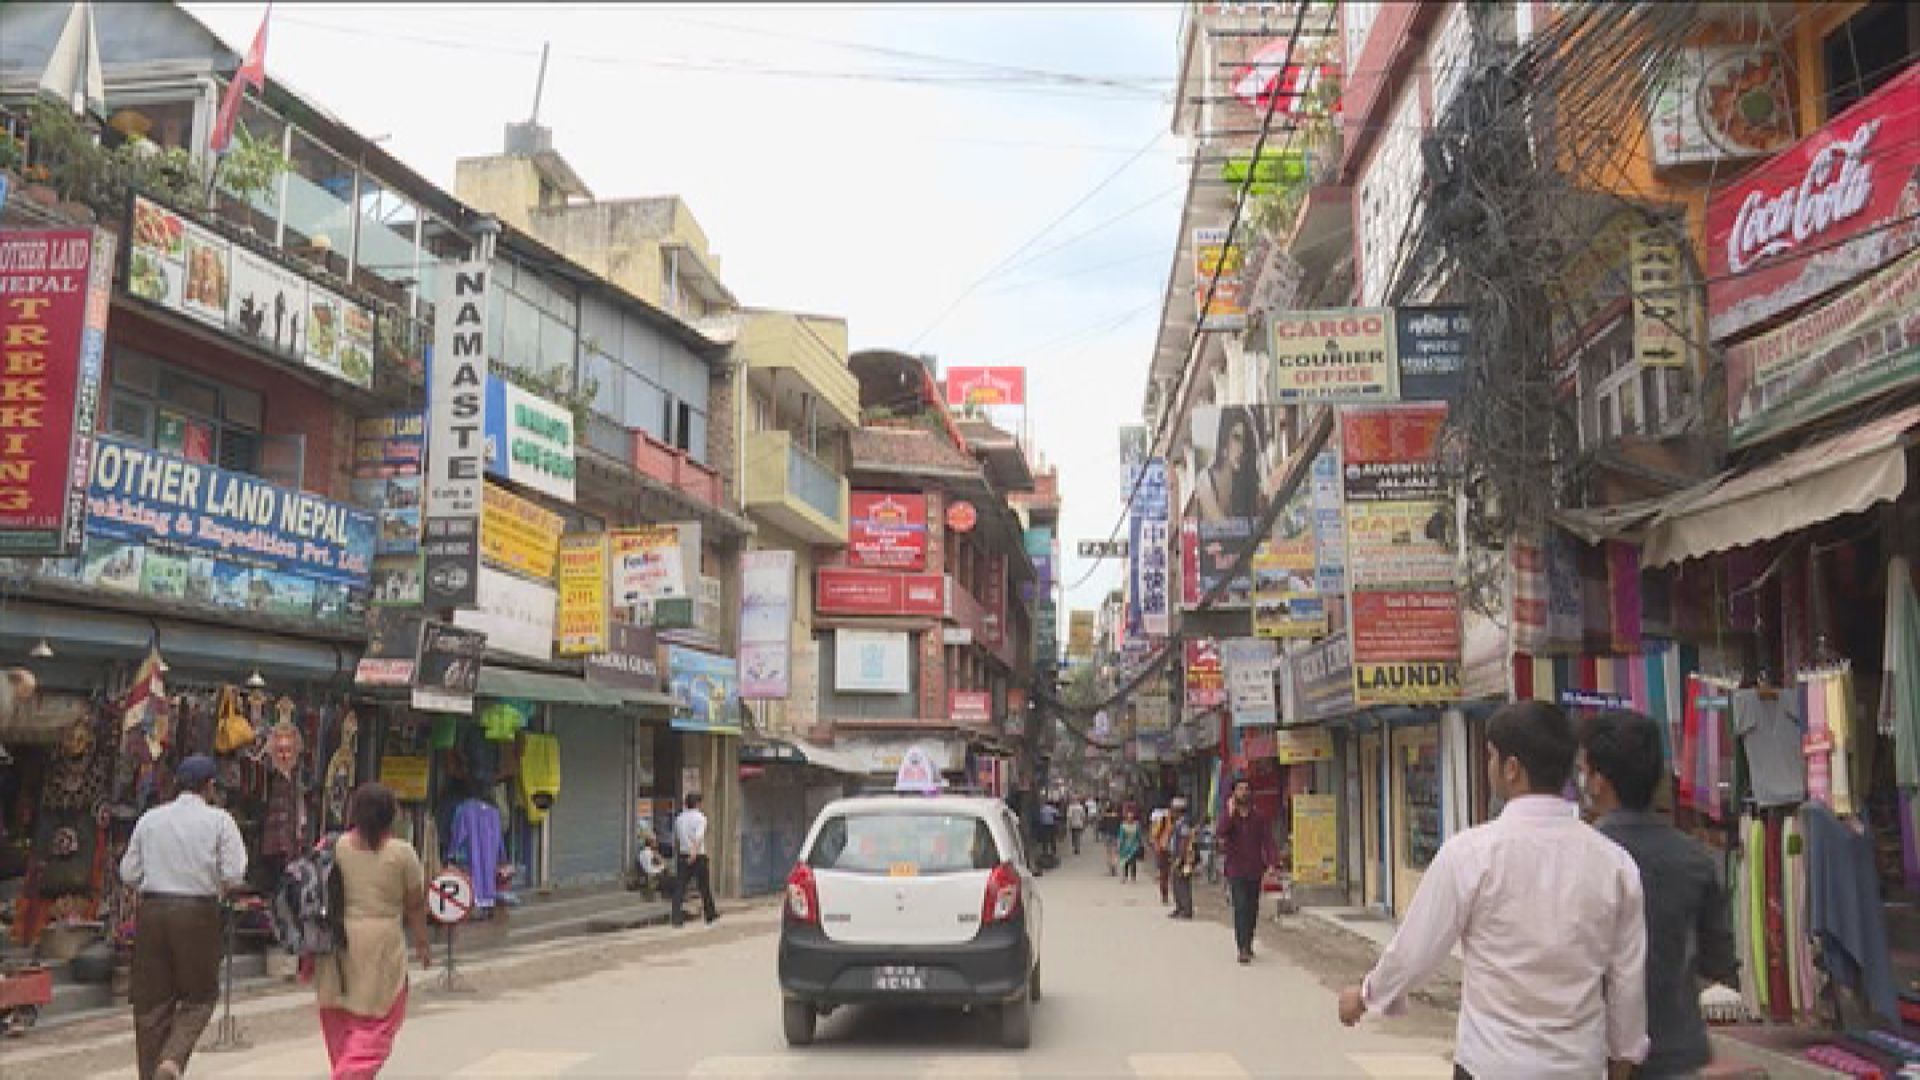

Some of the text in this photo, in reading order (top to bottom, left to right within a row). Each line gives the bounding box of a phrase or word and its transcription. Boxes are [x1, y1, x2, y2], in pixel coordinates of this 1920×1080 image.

[1729, 117, 1881, 273] Coca-Cola
[50, 237, 89, 271] LAND
[1279, 318, 1381, 337] CARGO
[1325, 339, 1339, 350] &
[1279, 350, 1385, 367] COURIER
[1296, 366, 1373, 385] OFFICE
[448, 272, 484, 480] NAMASTE
[90, 441, 348, 546] OTHER LAND NEPAL
[175, 513, 193, 534] &
[199, 515, 298, 557] Expedition
